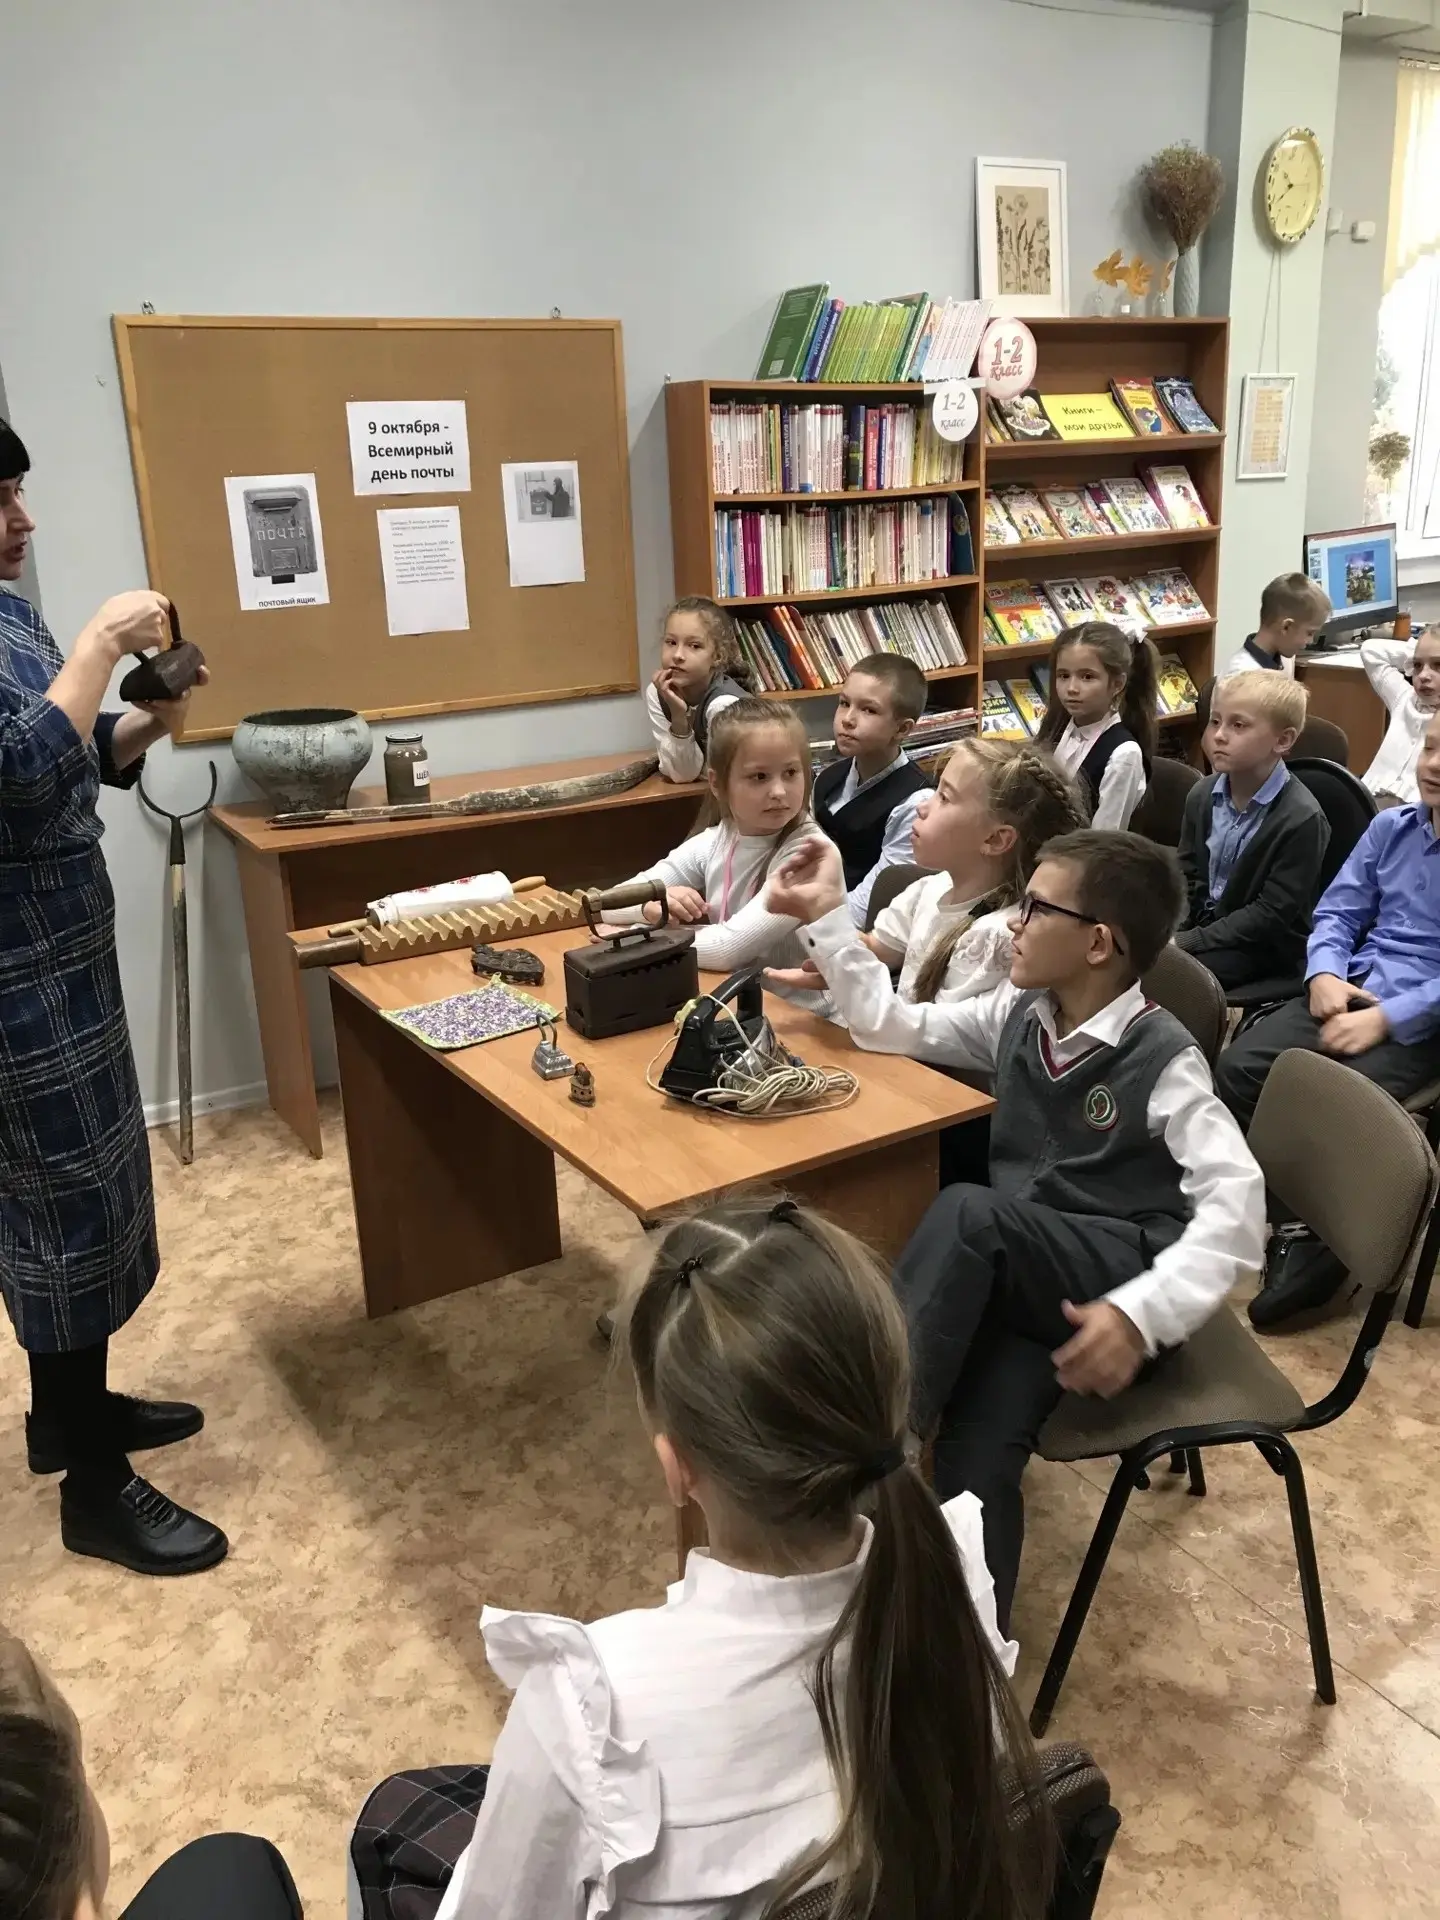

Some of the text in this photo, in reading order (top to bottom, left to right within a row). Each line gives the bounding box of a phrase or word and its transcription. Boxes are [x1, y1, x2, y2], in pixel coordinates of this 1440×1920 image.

[991, 336, 1023, 365] 1-2
[942, 392, 966, 410] 1-2
[1062, 406, 1095, 415] Книги
[368, 421, 377, 434] 9
[381, 420, 440, 436] октября
[1088, 422, 1123, 431] друзья
[368, 441, 453, 459] Всемирный
[371, 468, 454, 483] день почты
[256, 527, 306, 540] ПОЧТА
